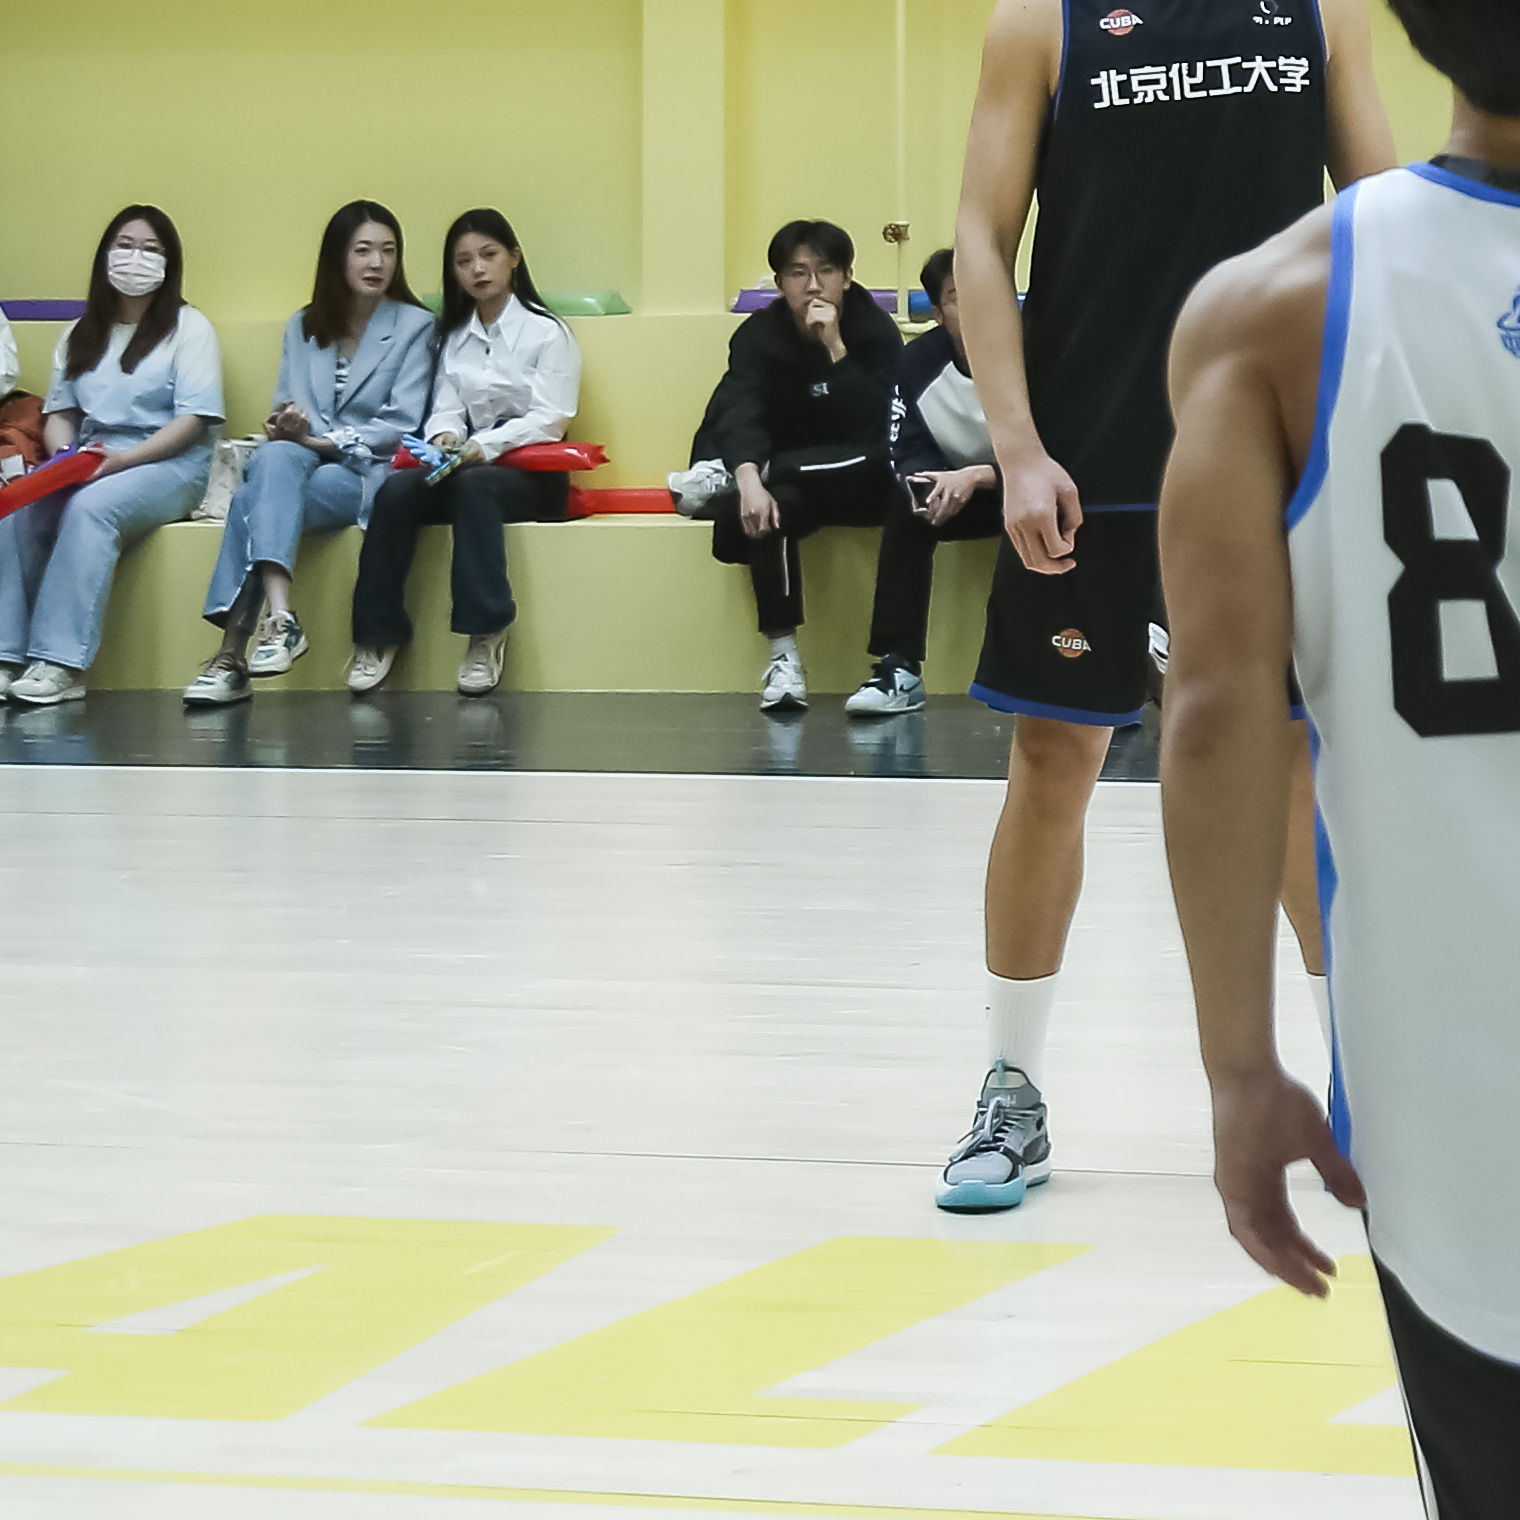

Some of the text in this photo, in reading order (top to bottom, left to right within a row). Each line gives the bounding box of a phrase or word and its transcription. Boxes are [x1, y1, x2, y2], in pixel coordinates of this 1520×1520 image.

[1099, 12, 1143, 30] CUBA
[1090, 55, 1310, 109] 北京化工大学
[1052, 635, 1092, 651] CUBA
